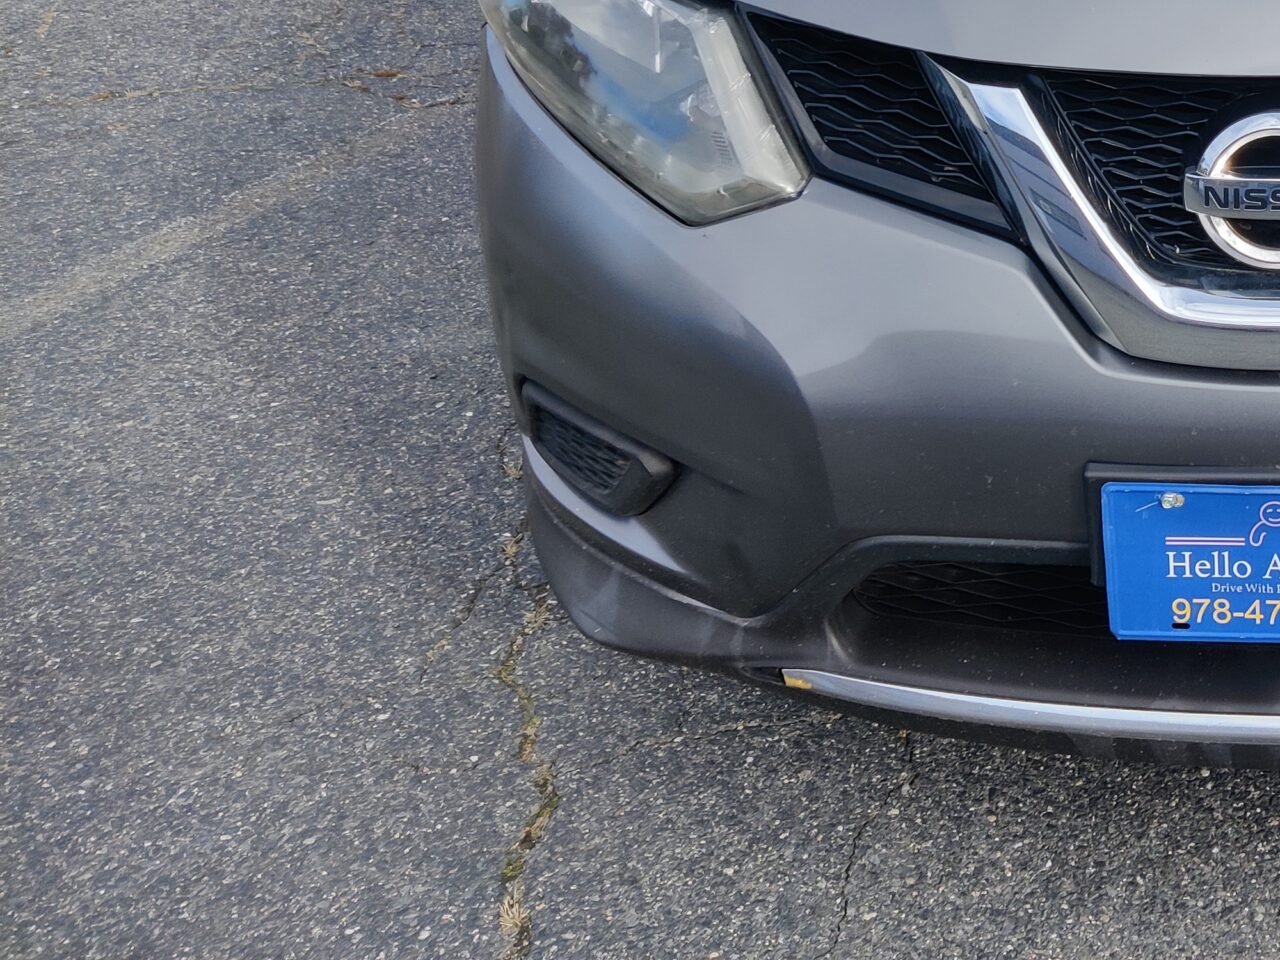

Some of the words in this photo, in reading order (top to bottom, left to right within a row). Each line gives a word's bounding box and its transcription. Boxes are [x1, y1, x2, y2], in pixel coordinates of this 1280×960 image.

[1165, 551, 1252, 578] Hello
[1211, 583, 1243, 593] Drive
[1245, 583, 1274, 594] With
